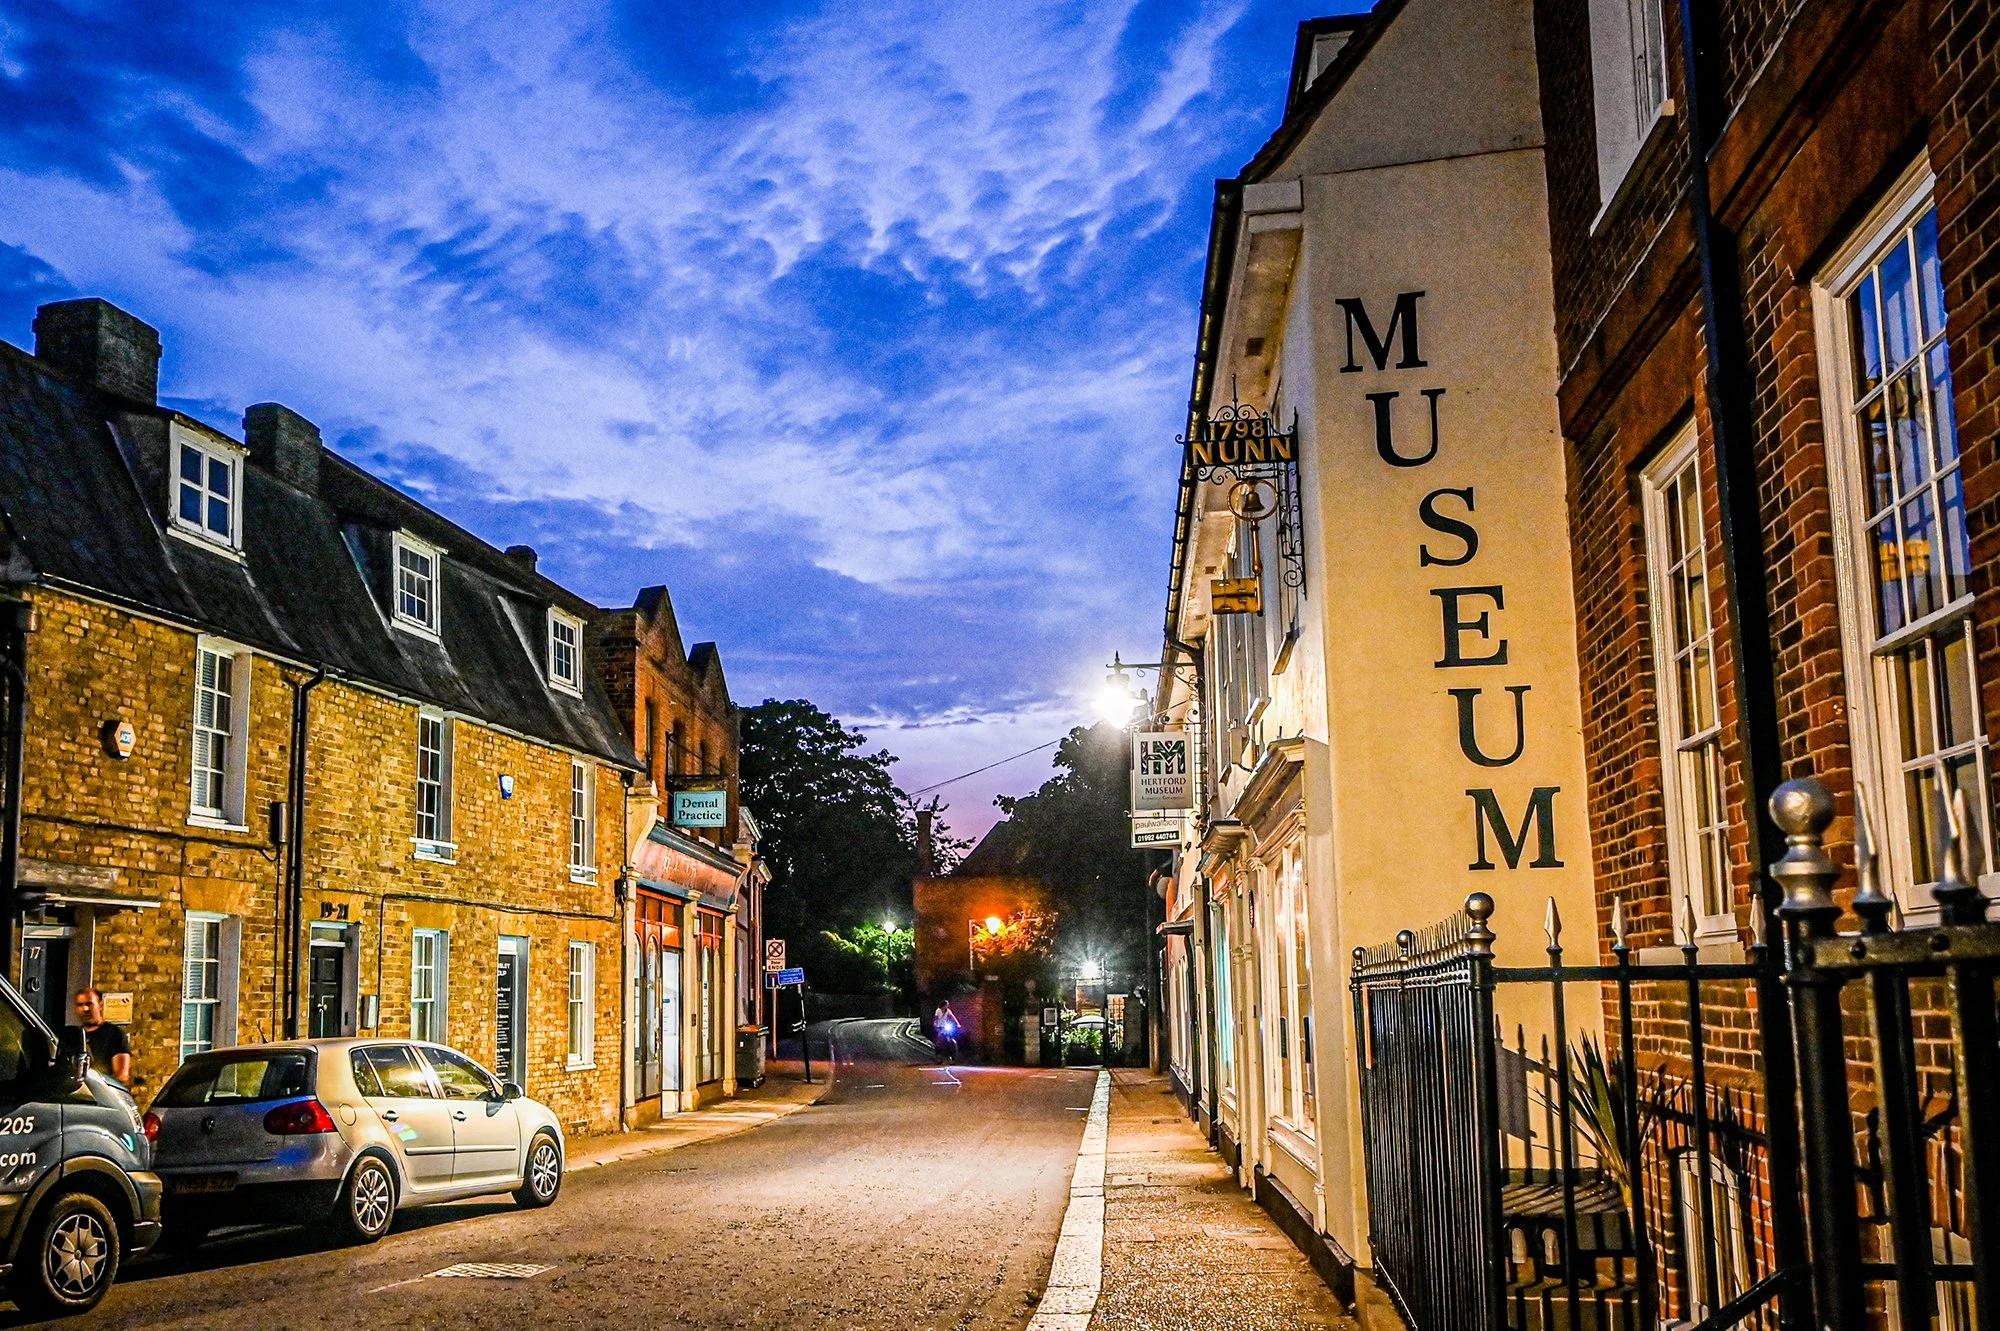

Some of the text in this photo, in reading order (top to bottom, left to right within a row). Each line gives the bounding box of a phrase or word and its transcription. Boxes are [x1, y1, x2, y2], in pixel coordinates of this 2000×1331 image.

[1210, 421, 1265, 440] 1798
[1192, 437, 1292, 465] NUNN
[1335, 290, 1565, 871] MUSEUM
[1141, 777, 1187, 786] HERTFORD
[1145, 786, 1183, 795] MUSEUM
[682, 798, 718, 808] Dental
[678, 810, 722, 820] Practice
[1137, 832, 1177, 842] 01992 440744
[29, 946, 41, 960] 17
